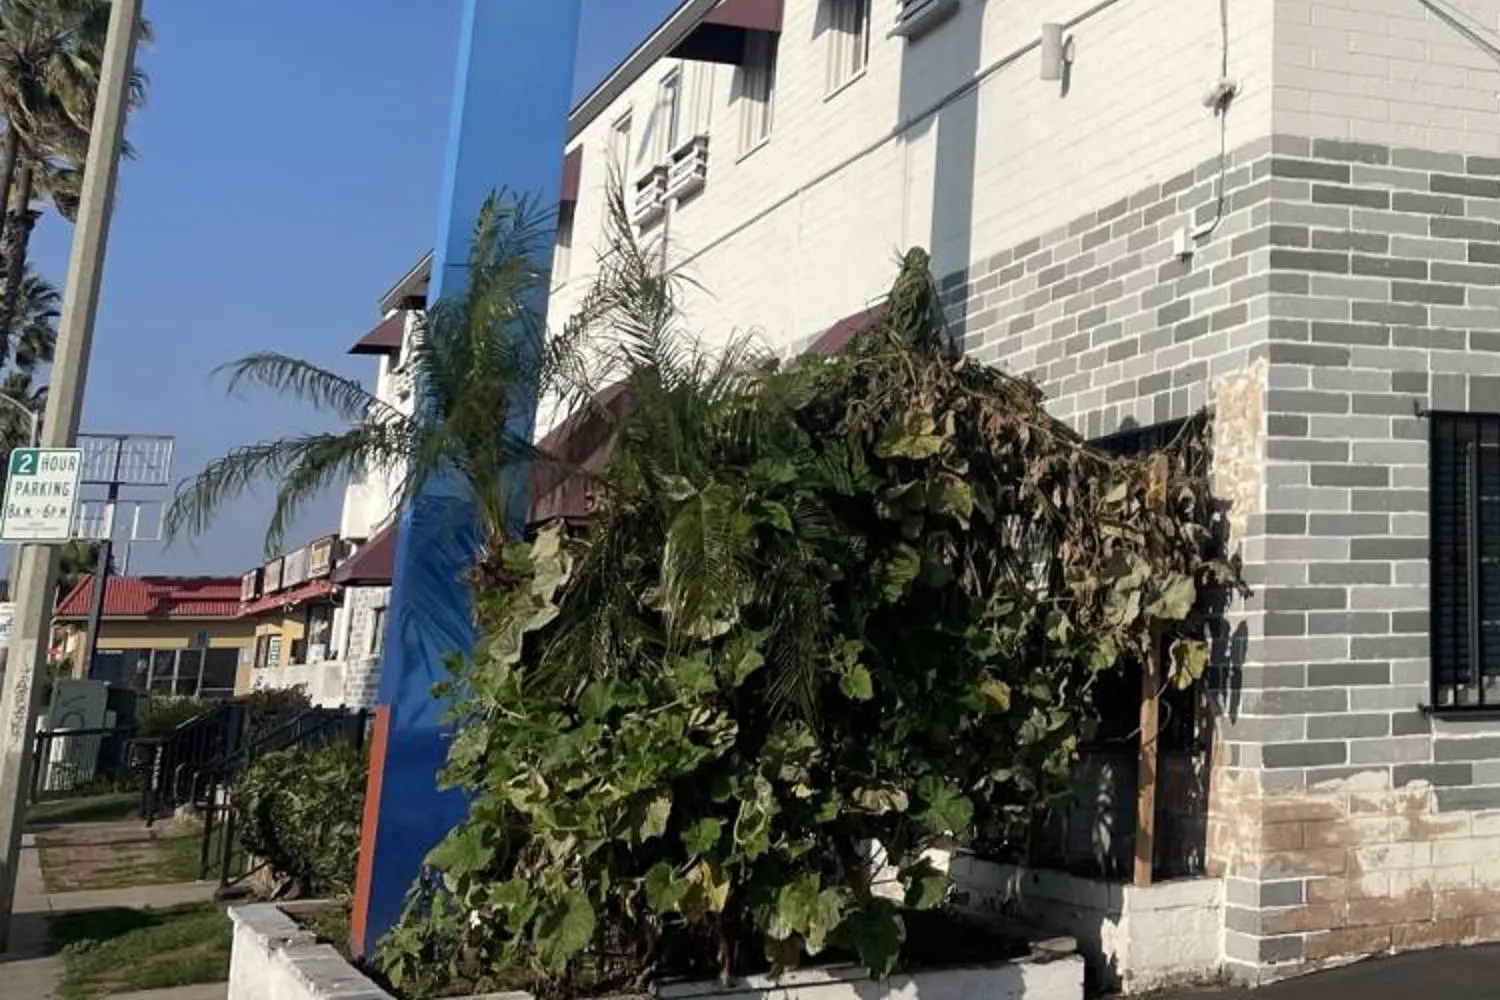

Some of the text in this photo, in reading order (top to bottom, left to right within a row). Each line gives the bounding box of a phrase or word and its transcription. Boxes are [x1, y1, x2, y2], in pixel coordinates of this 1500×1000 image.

[18, 453, 77, 474] 2 HOUR
[15, 481, 71, 497] PARKING
